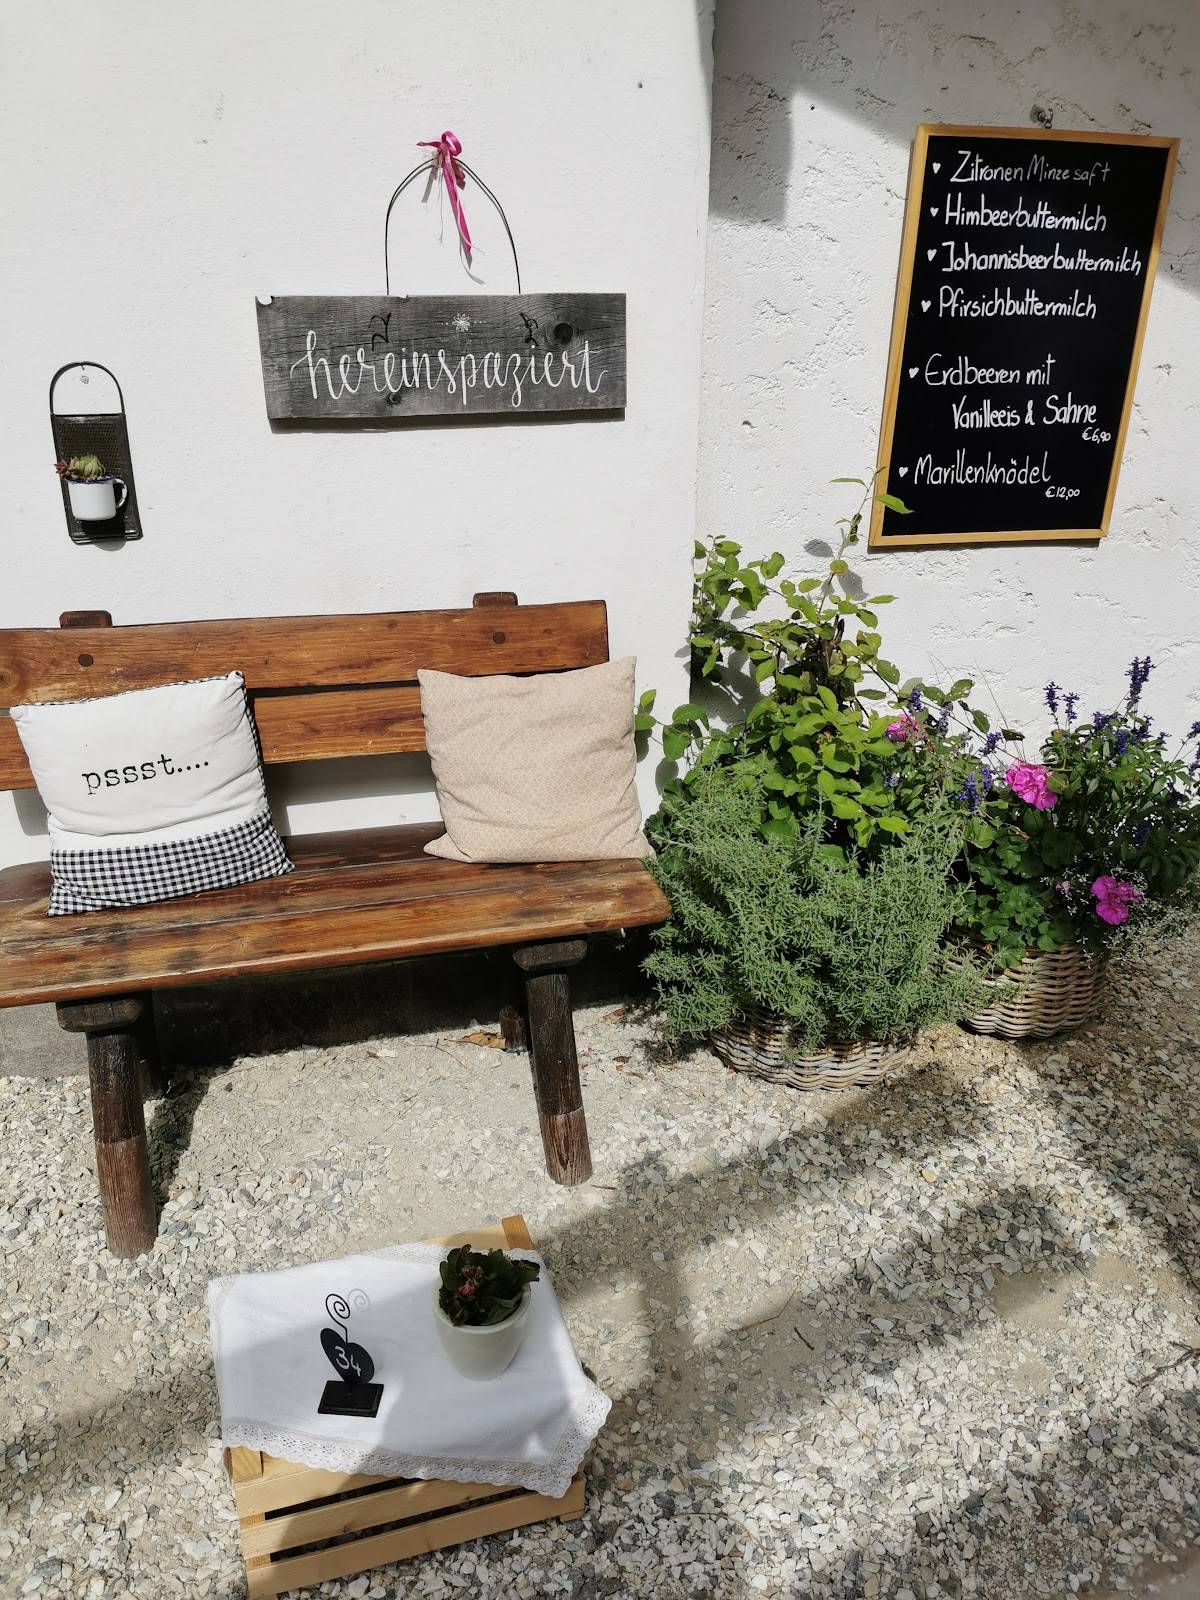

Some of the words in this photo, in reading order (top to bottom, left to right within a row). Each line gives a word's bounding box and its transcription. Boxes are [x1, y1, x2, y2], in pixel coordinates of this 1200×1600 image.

[950, 150, 1023, 183] Zitronen
[945, 192, 1107, 232] Himbeerbuttermilch
[941, 241, 1142, 276] Johannisbeerbuttermilch
[938, 285, 1097, 319] Pfirsichbuttermilch
[290, 330, 608, 407] hereinspaziert
[925, 353, 1020, 386] Erdbeeren
[1025, 354, 1056, 386] mit
[952, 395, 1020, 430] Vanilleeis
[1025, 400, 1035, 426] &
[1042, 392, 1097, 425] Sahne
[1081, 426, 1112, 444] €6,90
[914, 448, 1051, 485] Marillenknödel
[1045, 486, 1080, 498] €12,00
[81, 753, 209, 795] pssst....
[334, 1345, 361, 1377] 34
